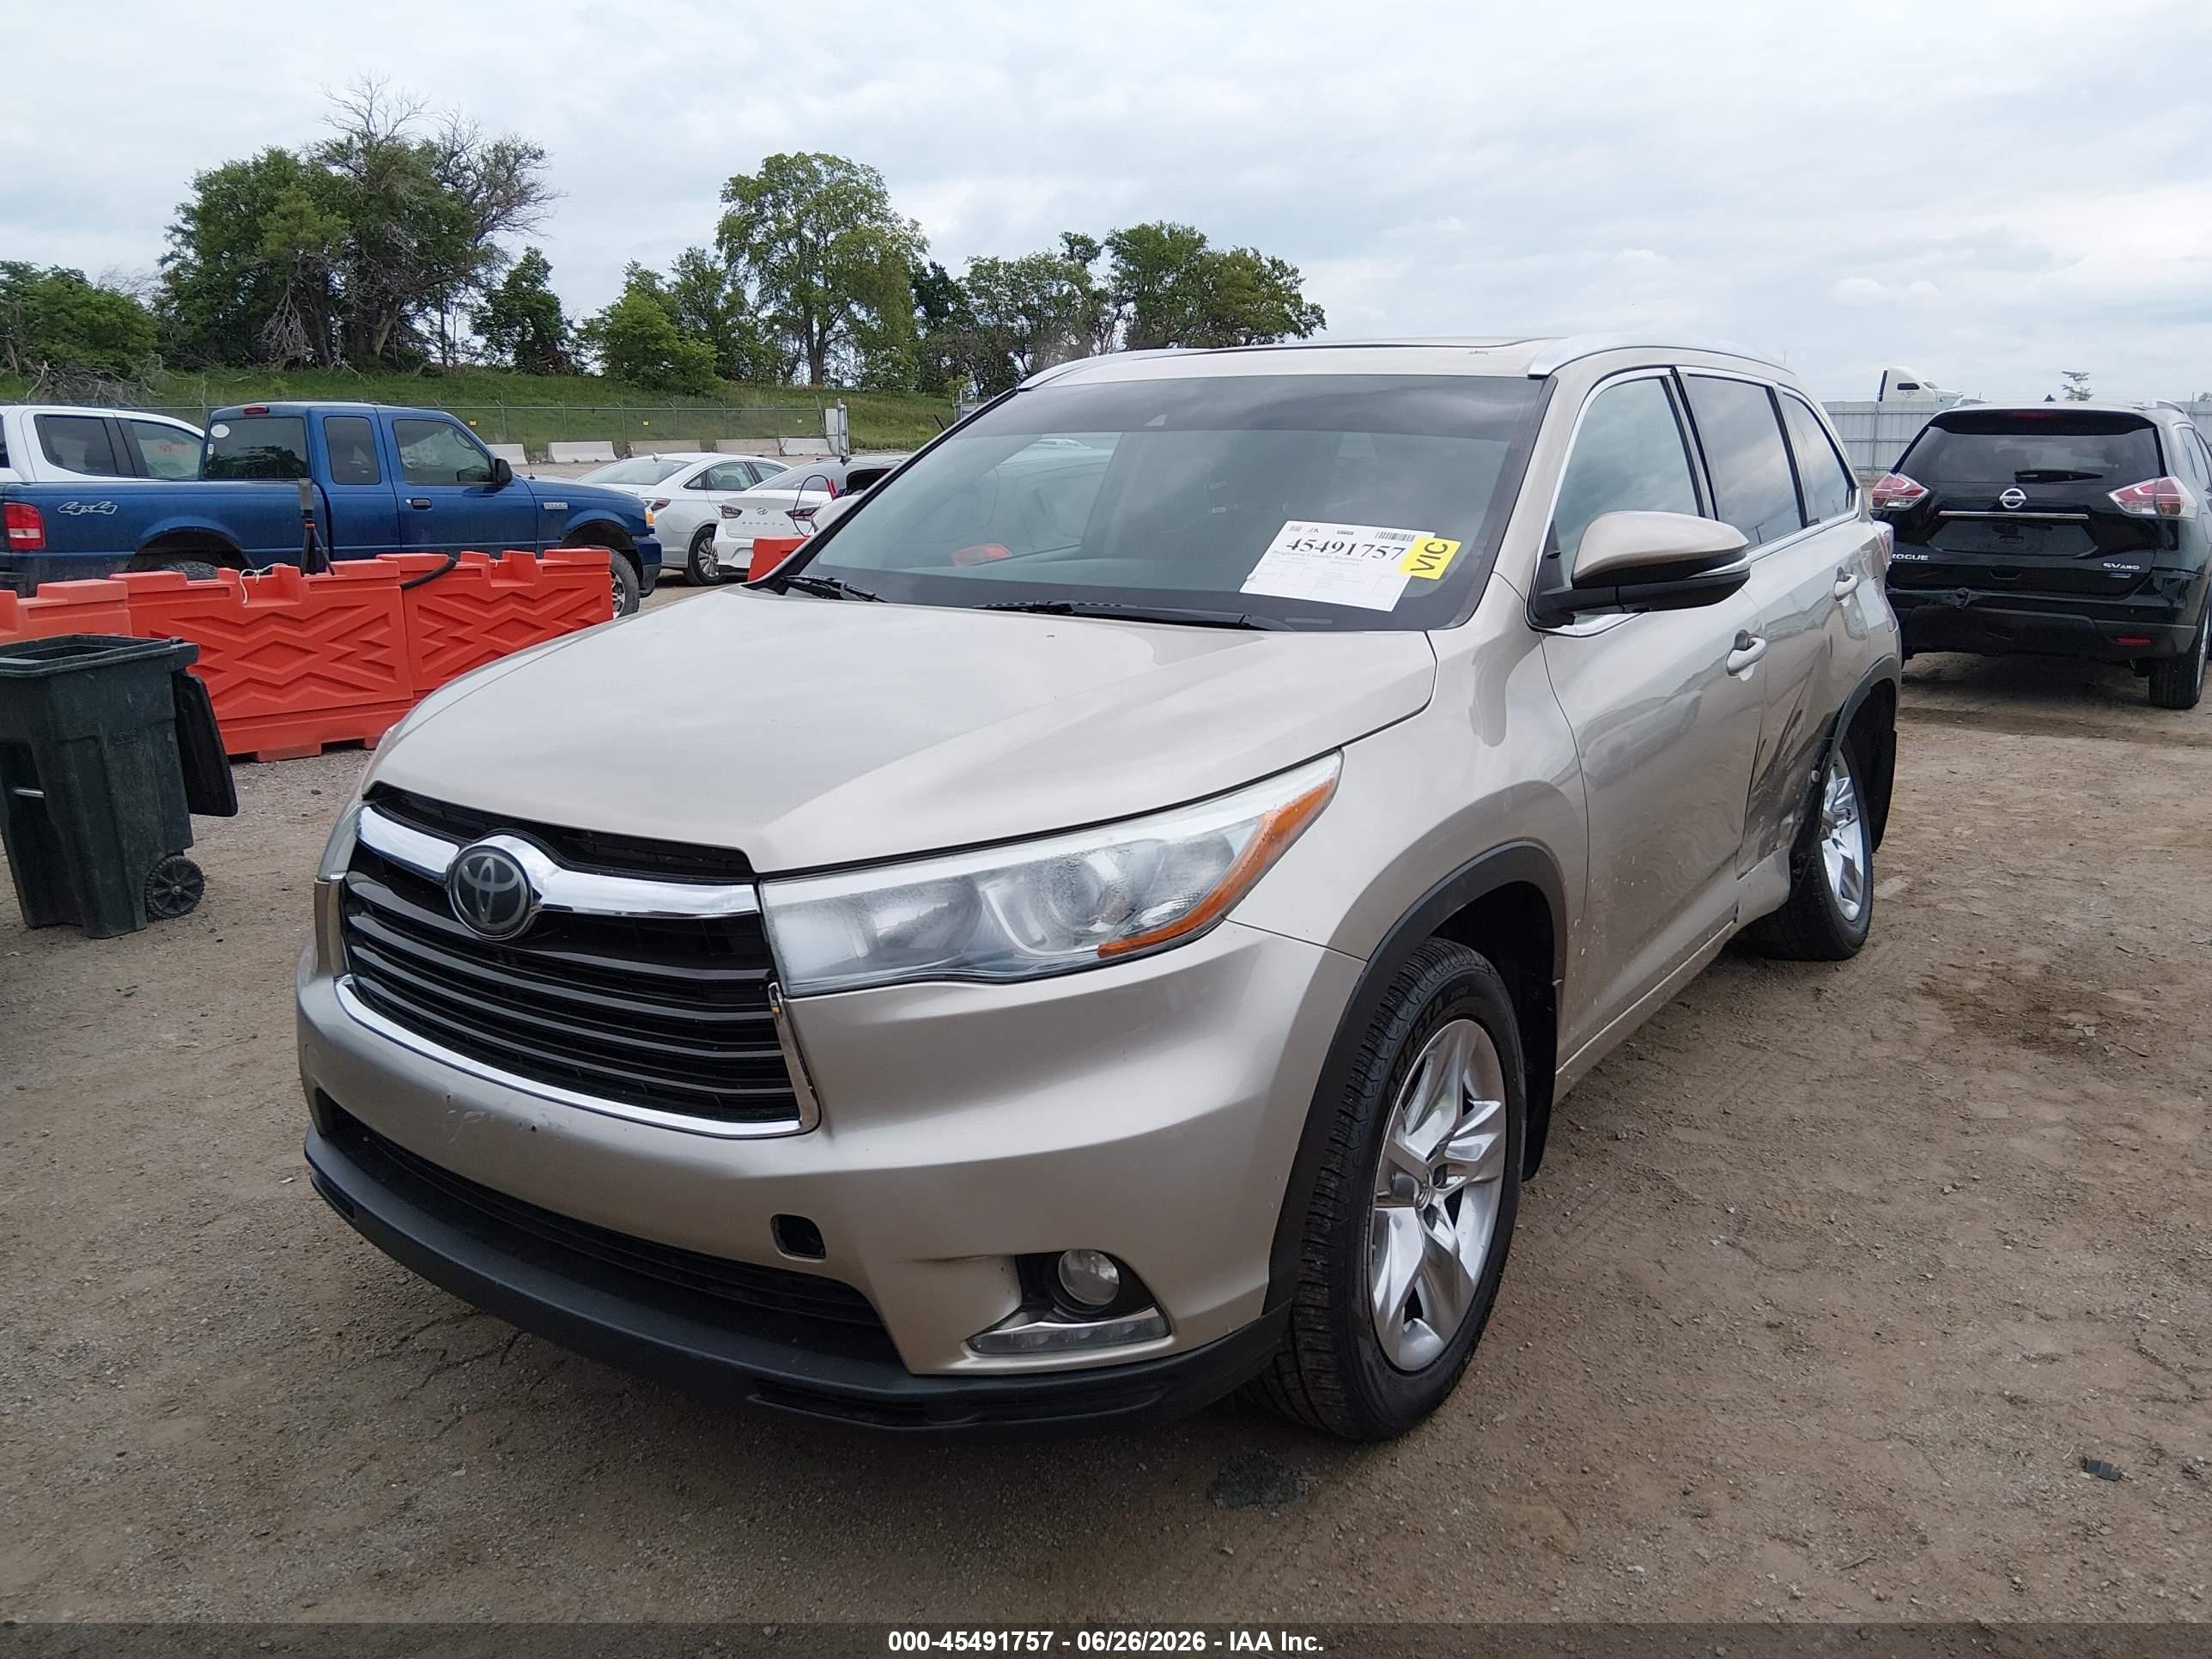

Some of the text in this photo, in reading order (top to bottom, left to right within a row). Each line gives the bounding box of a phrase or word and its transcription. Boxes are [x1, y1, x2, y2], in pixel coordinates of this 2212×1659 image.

[58, 501, 118, 515] 4x4
[1286, 538, 1406, 561] 45491757
[1409, 541, 1449, 572] VIC
